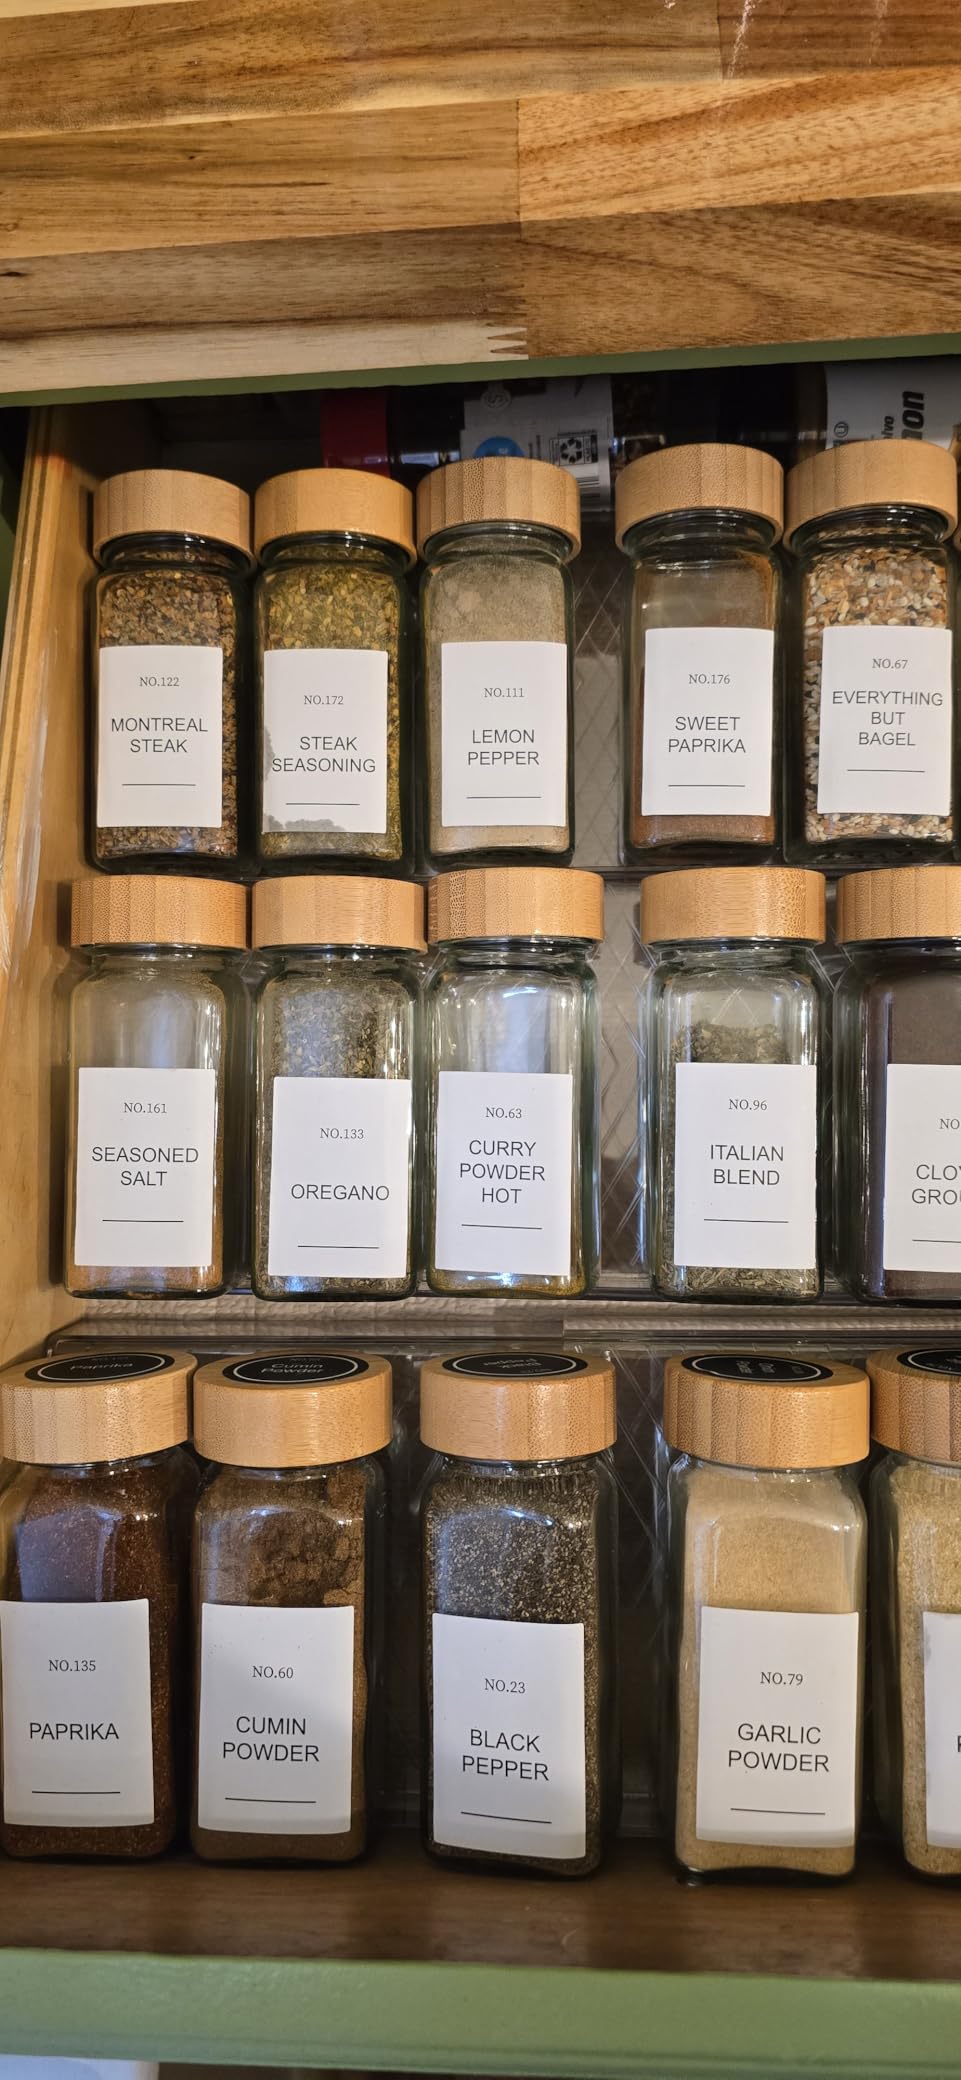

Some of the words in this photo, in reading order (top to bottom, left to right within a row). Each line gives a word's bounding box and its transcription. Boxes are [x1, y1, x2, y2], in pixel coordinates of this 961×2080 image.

[871, 658, 909, 670] NO.67
[139, 676, 180, 687] NO.122
[688, 673, 731, 685] NO.176
[303, 694, 344, 706] NO.172
[483, 687, 525, 698] NO.111
[832, 690, 944, 707] EVERYTHING
[111, 716, 209, 733] MONTREAL
[674, 715, 741, 732] SWEET
[870, 711, 906, 726] BUT
[299, 735, 358, 752] STEAK
[472, 728, 535, 744] LEMON
[858, 731, 917, 747] BAGEL
[129, 738, 188, 754] STEAK
[668, 737, 747, 754] PAPRIKA
[271, 757, 376, 773] SEASONING
[467, 750, 540, 766] PEPPER
[123, 1102, 167, 1114] NO.161
[485, 1106, 523, 1120] NO.63
[728, 1098, 768, 1111] NO.96
[319, 1127, 365, 1140] NO.133
[91, 1146, 199, 1164] SEASONED
[468, 1139, 537, 1158] CURRY
[710, 1144, 784, 1162] ITALIAN
[120, 1170, 168, 1187] SALT
[459, 1162, 546, 1182] POWDER
[713, 1168, 781, 1186] BLEND
[915, 1163, 961, 1181] CLO
[290, 1183, 390, 1201] OREGANO
[481, 1186, 523, 1205] HOT
[911, 1187, 961, 1206] GRO
[48, 1659, 97, 1673] NO.135
[251, 1665, 294, 1680] NO.60
[484, 1677, 526, 1695] NO.23
[759, 1671, 804, 1687] NO.79
[29, 1722, 120, 1741] PAPRIKA
[235, 1715, 307, 1736] CUMIN
[737, 1722, 822, 1745] GARLIC
[470, 1728, 541, 1754] BLACK
[222, 1741, 320, 1763] POWDER
[462, 1754, 550, 1782] PEPPER
[728, 1749, 830, 1773] POWDER
